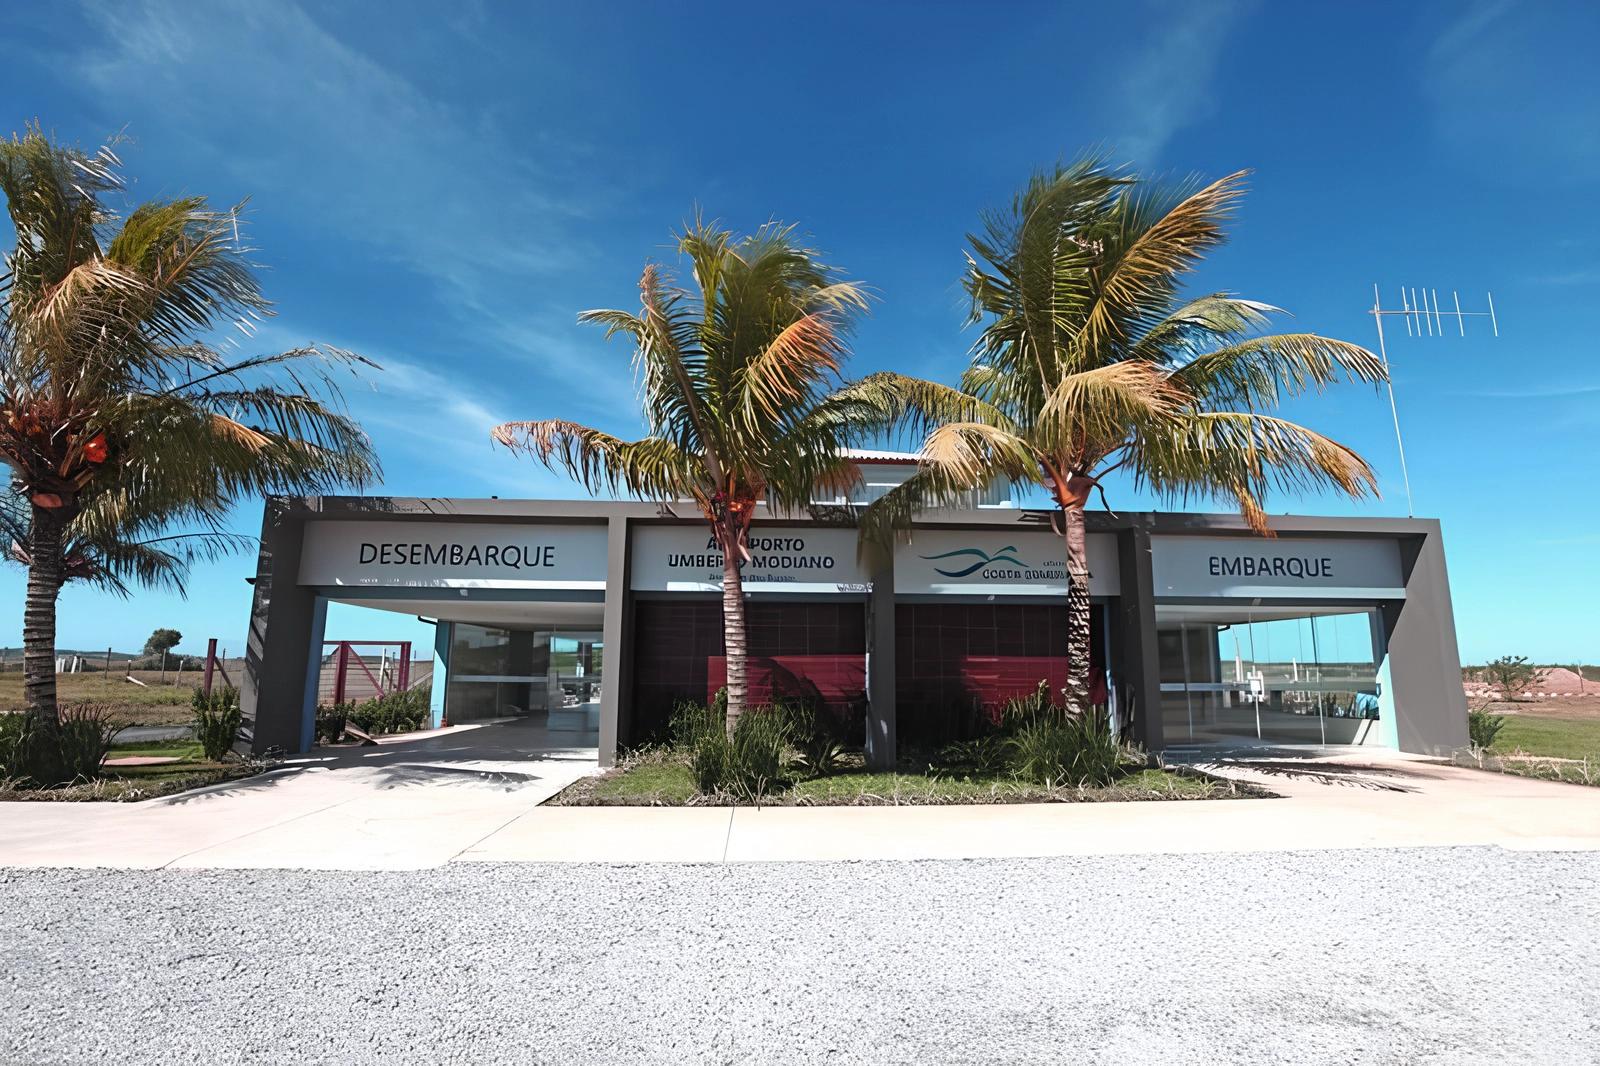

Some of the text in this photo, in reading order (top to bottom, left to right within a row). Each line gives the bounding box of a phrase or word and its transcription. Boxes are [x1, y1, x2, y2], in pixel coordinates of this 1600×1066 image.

[706, 537, 805, 551] APORTO
[359, 543, 555, 569] DESEMBARQUE
[668, 554, 835, 569] UMBERO MODIANO
[1209, 556, 1334, 579] EMBARQUE
